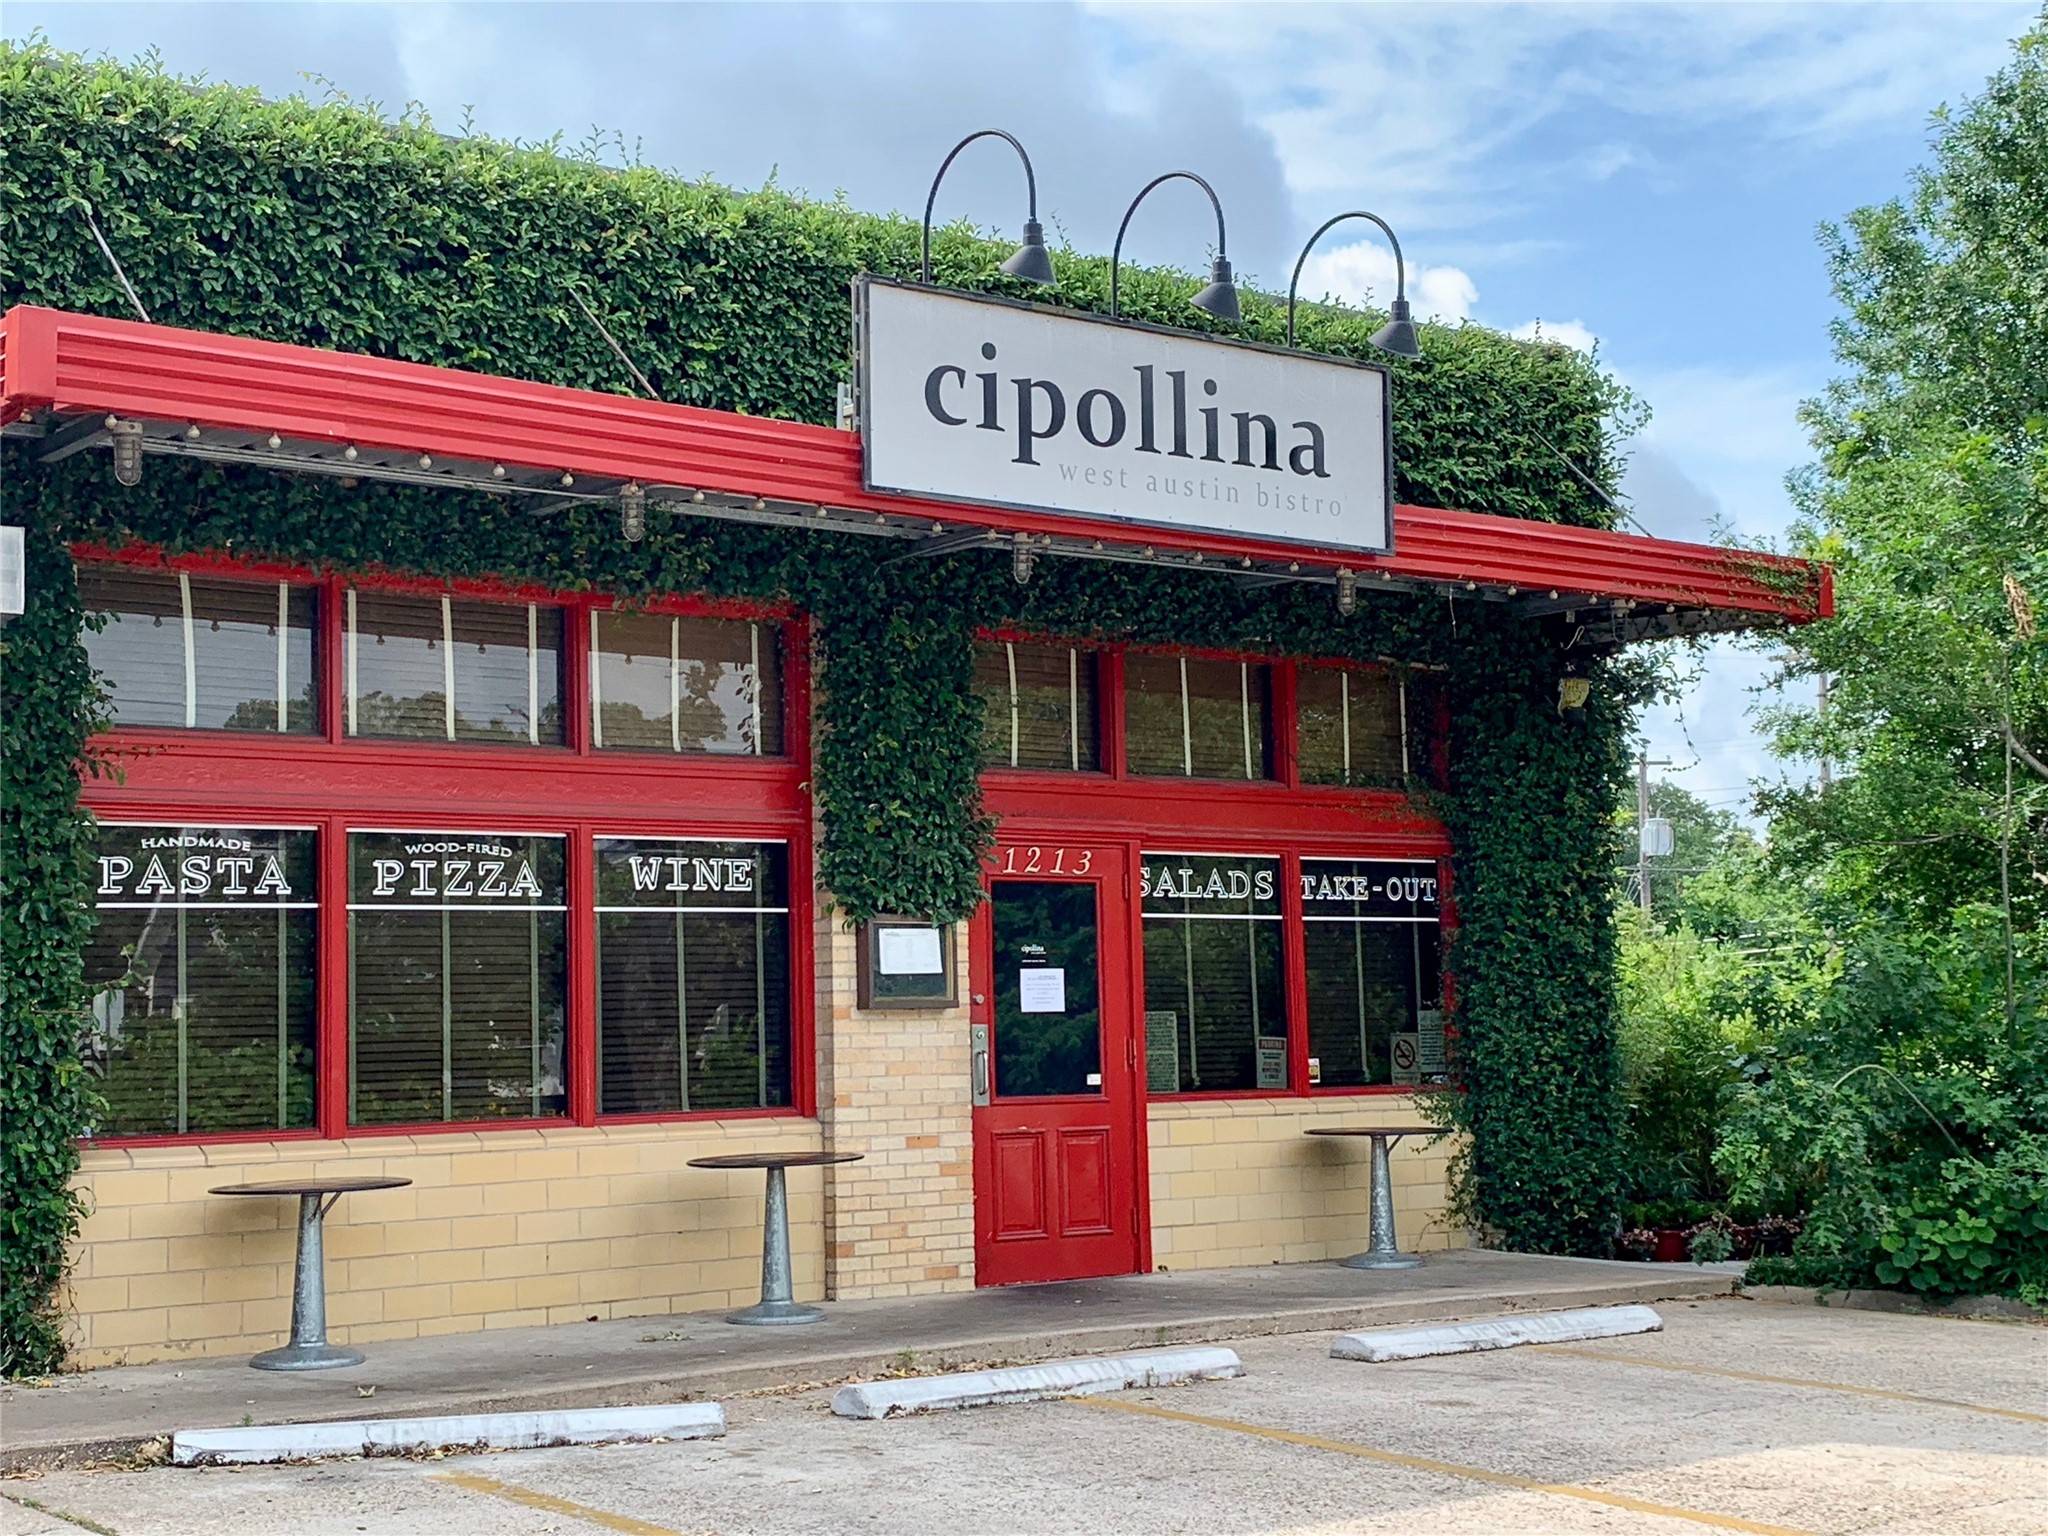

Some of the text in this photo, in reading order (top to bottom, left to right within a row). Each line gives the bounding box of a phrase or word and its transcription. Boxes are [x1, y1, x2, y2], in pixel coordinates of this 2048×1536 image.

[924, 342, 1331, 478] cipollina
[1059, 461, 1342, 517] west austin bistro
[141, 836, 252, 852] HANDMADE
[405, 842, 513, 859] WOOD-FIRED
[1002, 846, 1093, 876] 1213
[97, 854, 292, 895] PASTA
[372, 859, 543, 897] PIZZA
[629, 856, 754, 892] WINE
[1140, 866, 1274, 900] SALADS
[1300, 874, 1437, 901] TAKE-OUT
